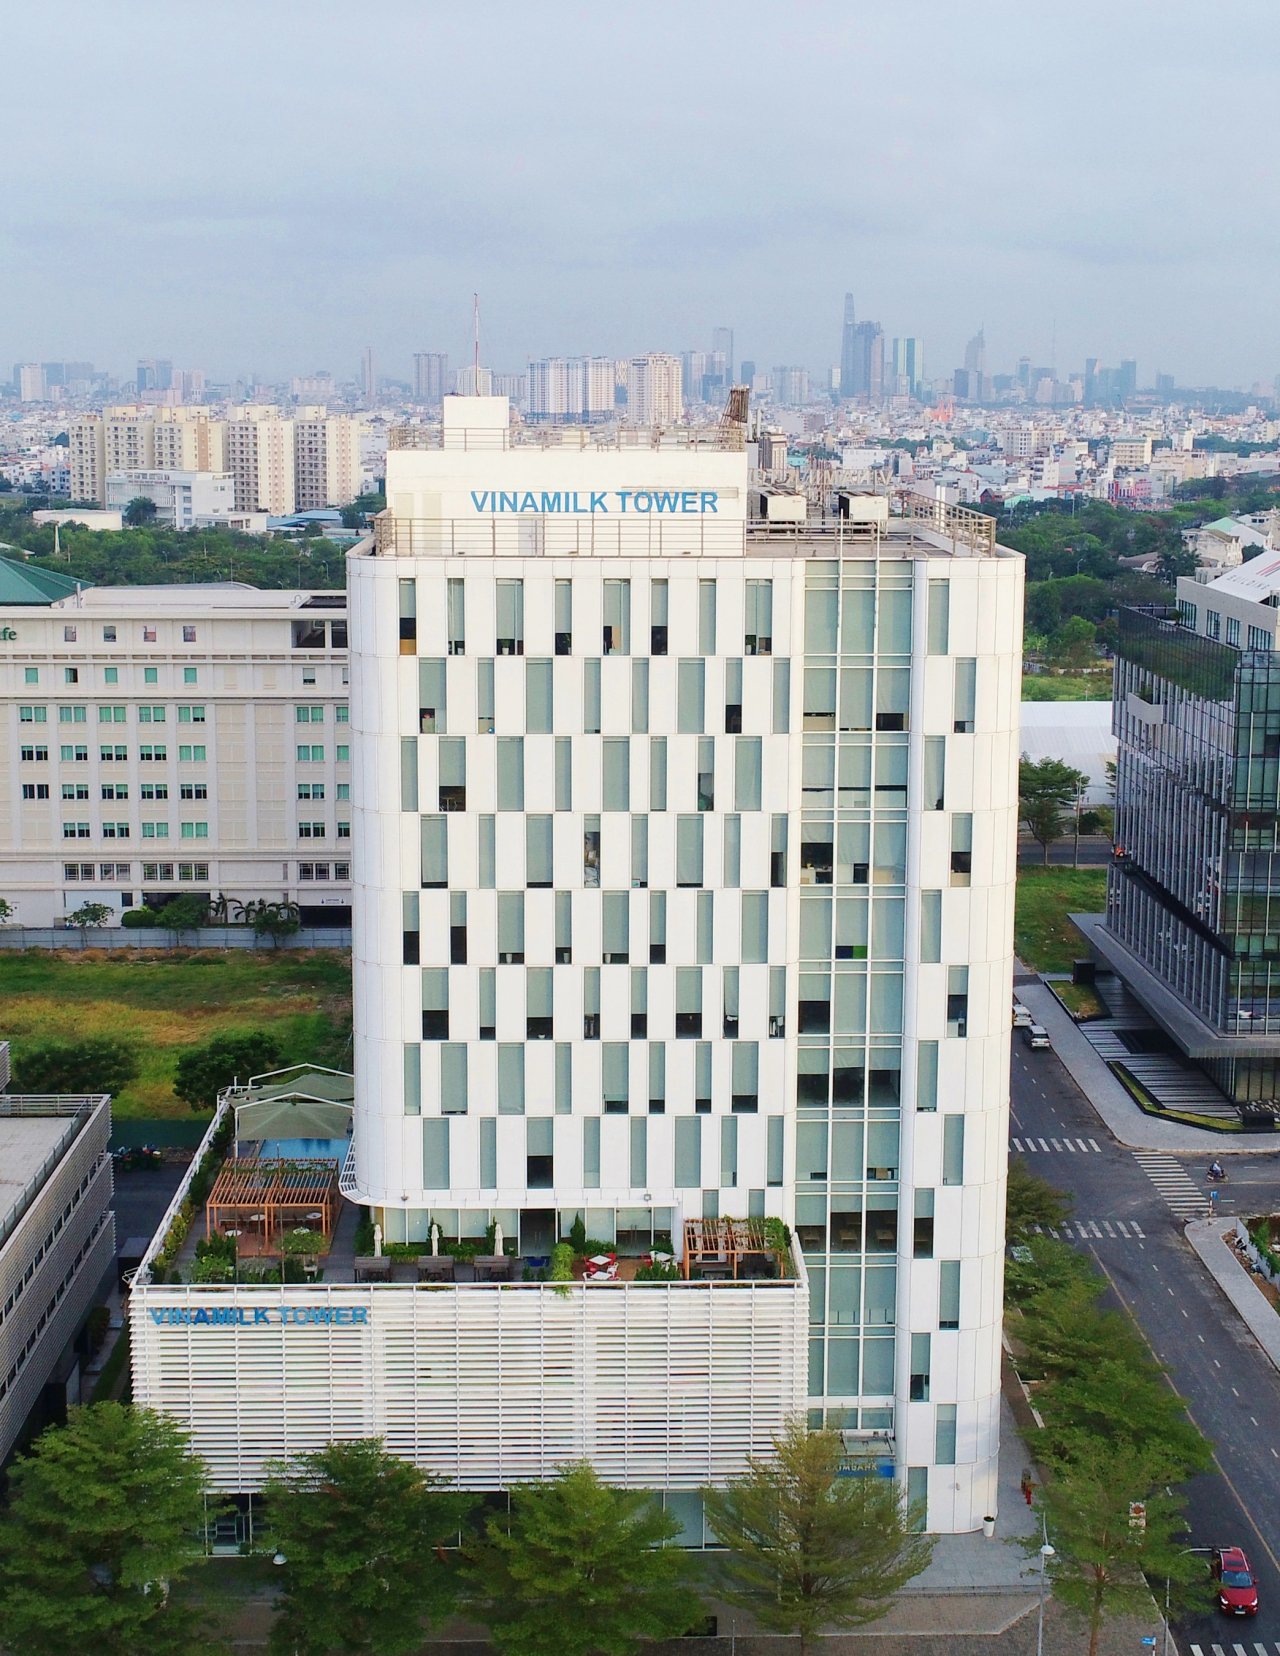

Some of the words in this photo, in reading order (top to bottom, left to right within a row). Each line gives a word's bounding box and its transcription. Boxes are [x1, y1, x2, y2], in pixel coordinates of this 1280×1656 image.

[470, 490, 608, 512] VINAMILK
[615, 491, 718, 513] TOWER
[0, 626, 17, 640] fe
[150, 1306, 270, 1325] VINAMILK
[277, 1306, 368, 1325] TOWER
